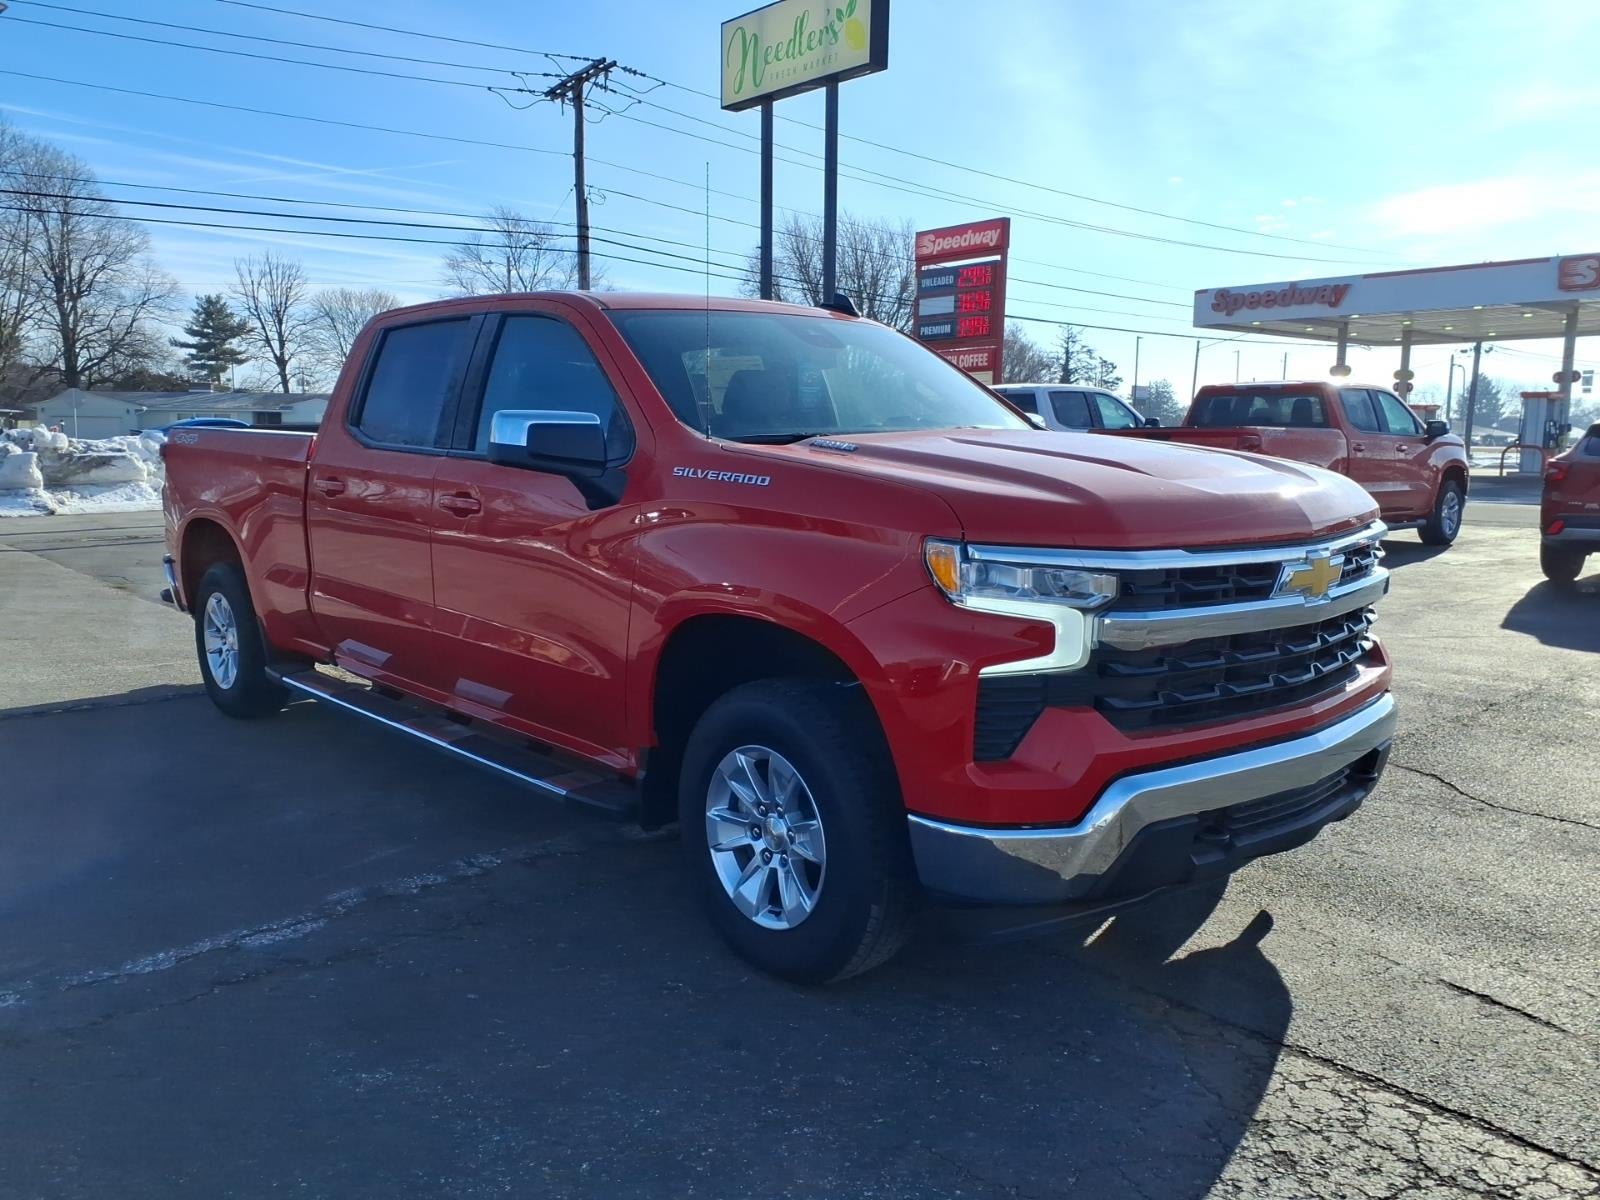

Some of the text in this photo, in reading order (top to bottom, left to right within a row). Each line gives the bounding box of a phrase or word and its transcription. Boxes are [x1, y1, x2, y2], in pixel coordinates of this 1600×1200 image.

[727, 8, 841, 95] Needler's
[769, 52, 839, 81] FRESH MARKET
[917, 229, 1001, 255] Speedway
[921, 275, 954, 288] UNLEADED
[1211, 282, 1353, 316] Speedway
[920, 324, 952, 336] PREMIUM
[959, 353, 989, 368] COFFEE
[672, 466, 771, 487] SILVERADO
